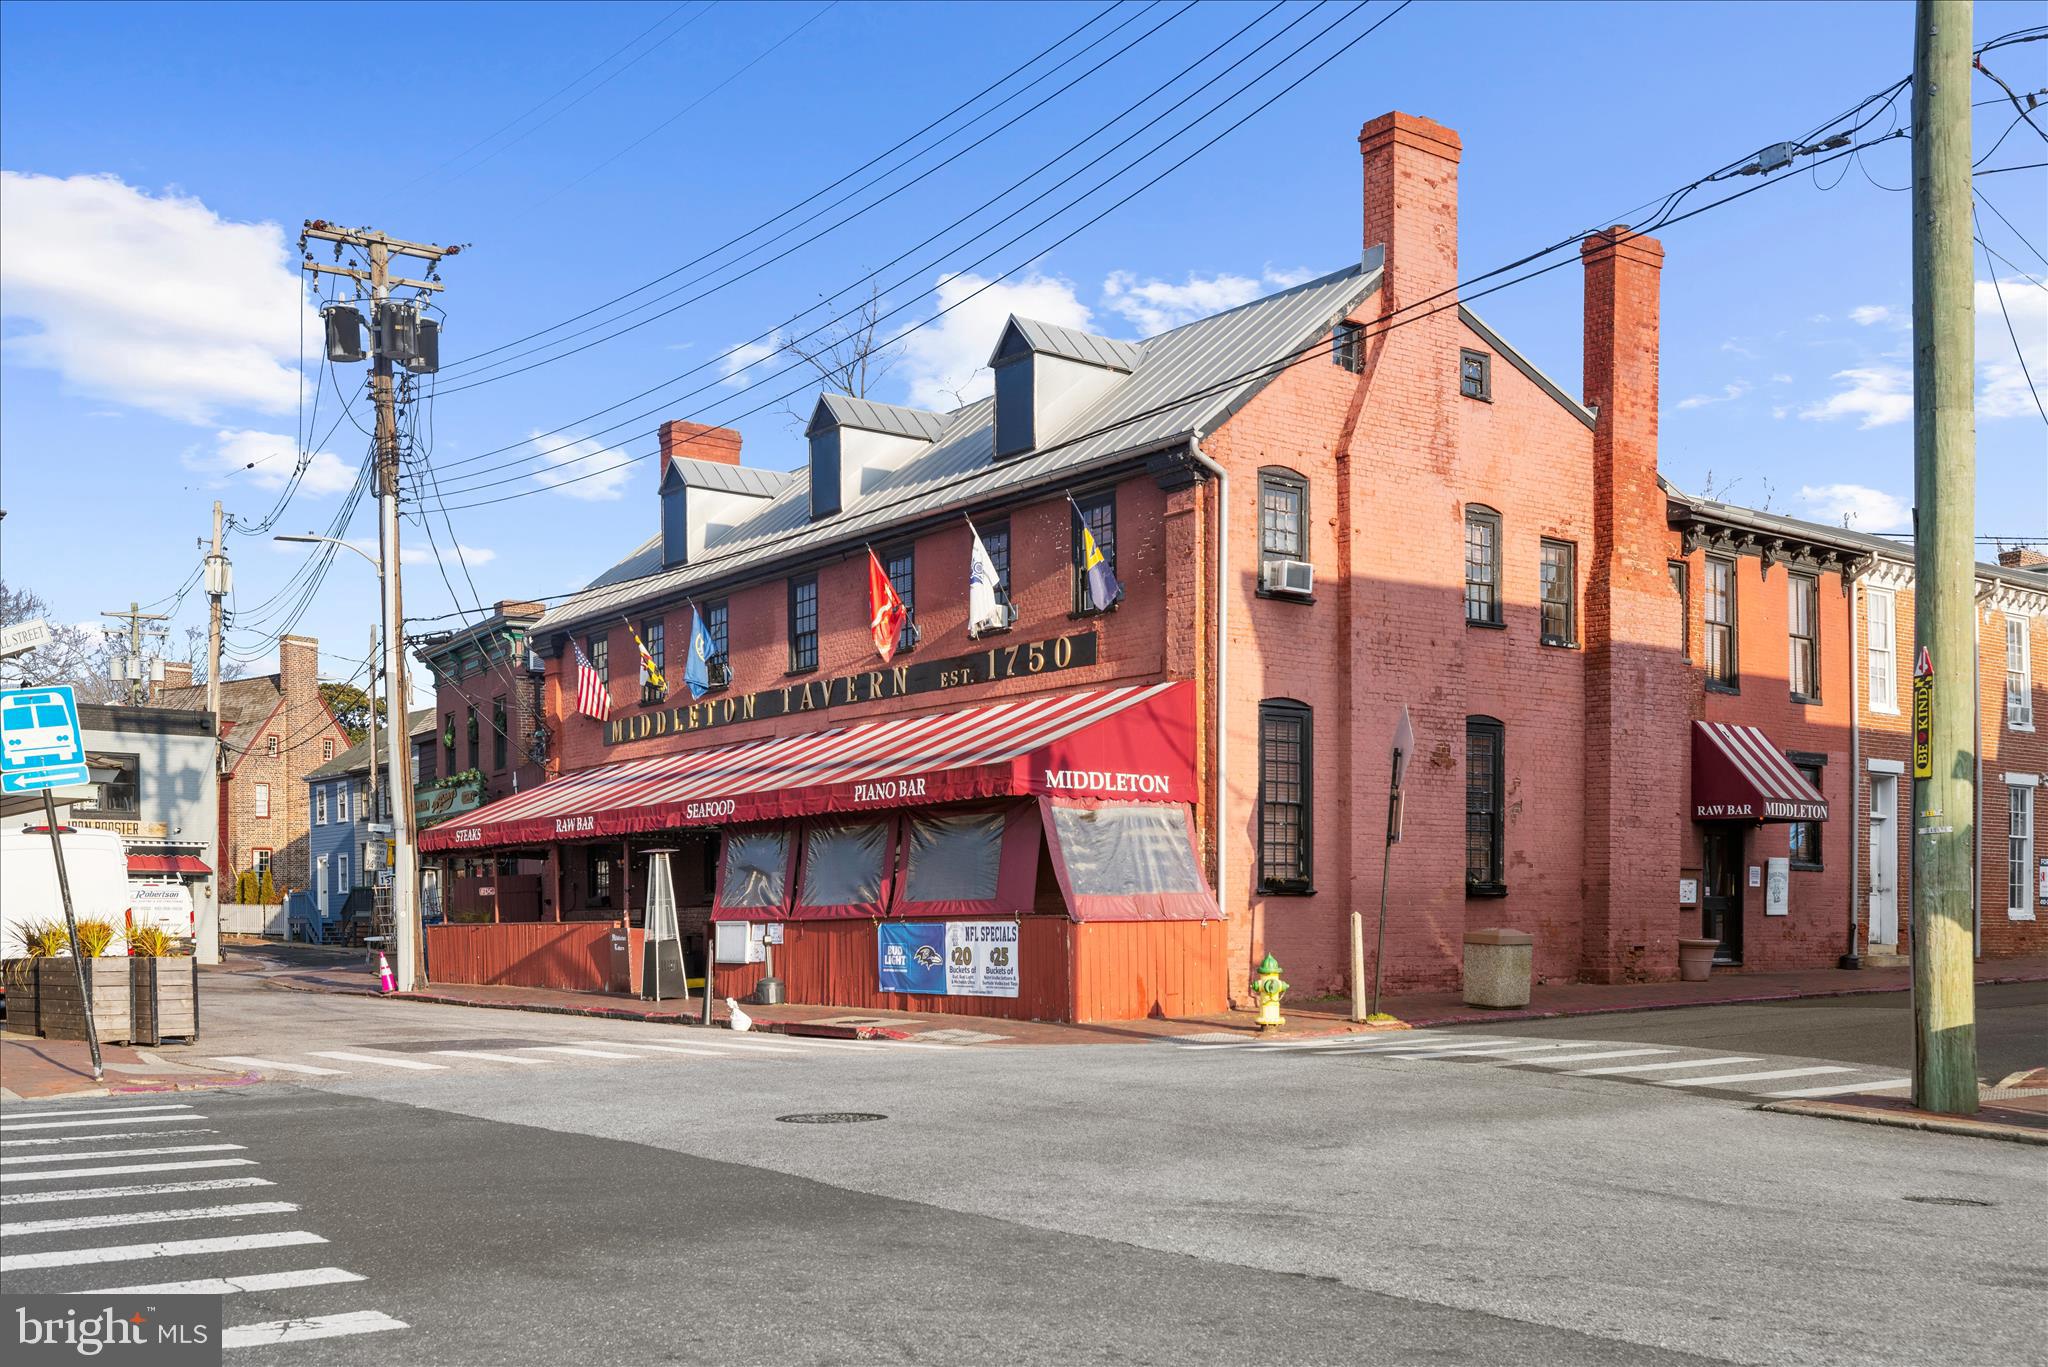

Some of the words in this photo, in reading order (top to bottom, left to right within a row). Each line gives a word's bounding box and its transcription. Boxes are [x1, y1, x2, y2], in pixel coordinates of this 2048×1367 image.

[12, 626, 44, 645] STREET
[611, 692, 756, 743] MIDDLETON
[780, 665, 909, 713] TAVERN
[940, 668, 975, 688] EST.
[987, 636, 1072, 680] 1750
[1918, 687, 1929, 730] KIND
[1917, 743, 1928, 765] BE
[854, 782, 895, 801] PIANO
[899, 778, 926, 797] BAR
[1045, 769, 1169, 794] MIDDLETON
[687, 799, 735, 819] SEAFOOD
[1697, 804, 1725, 816] RAW
[1727, 804, 1752, 815] BAR
[1765, 801, 1828, 819] MIDDLETON
[556, 818, 576, 833] RAW
[576, 816, 594, 831] BAR
[455, 828, 481, 842] STEAKS
[136, 890, 179, 898] Robertson
[965, 926, 979, 941] NFL
[981, 926, 1017, 942] SPECIALS
[887, 945, 903, 955] BUD
[884, 955, 906, 966] LIGHT
[949, 966, 970, 974] Buckets
[971, 966, 977, 974] of
[986, 966, 1007, 975] Buckets
[1007, 967, 1014, 975] of
